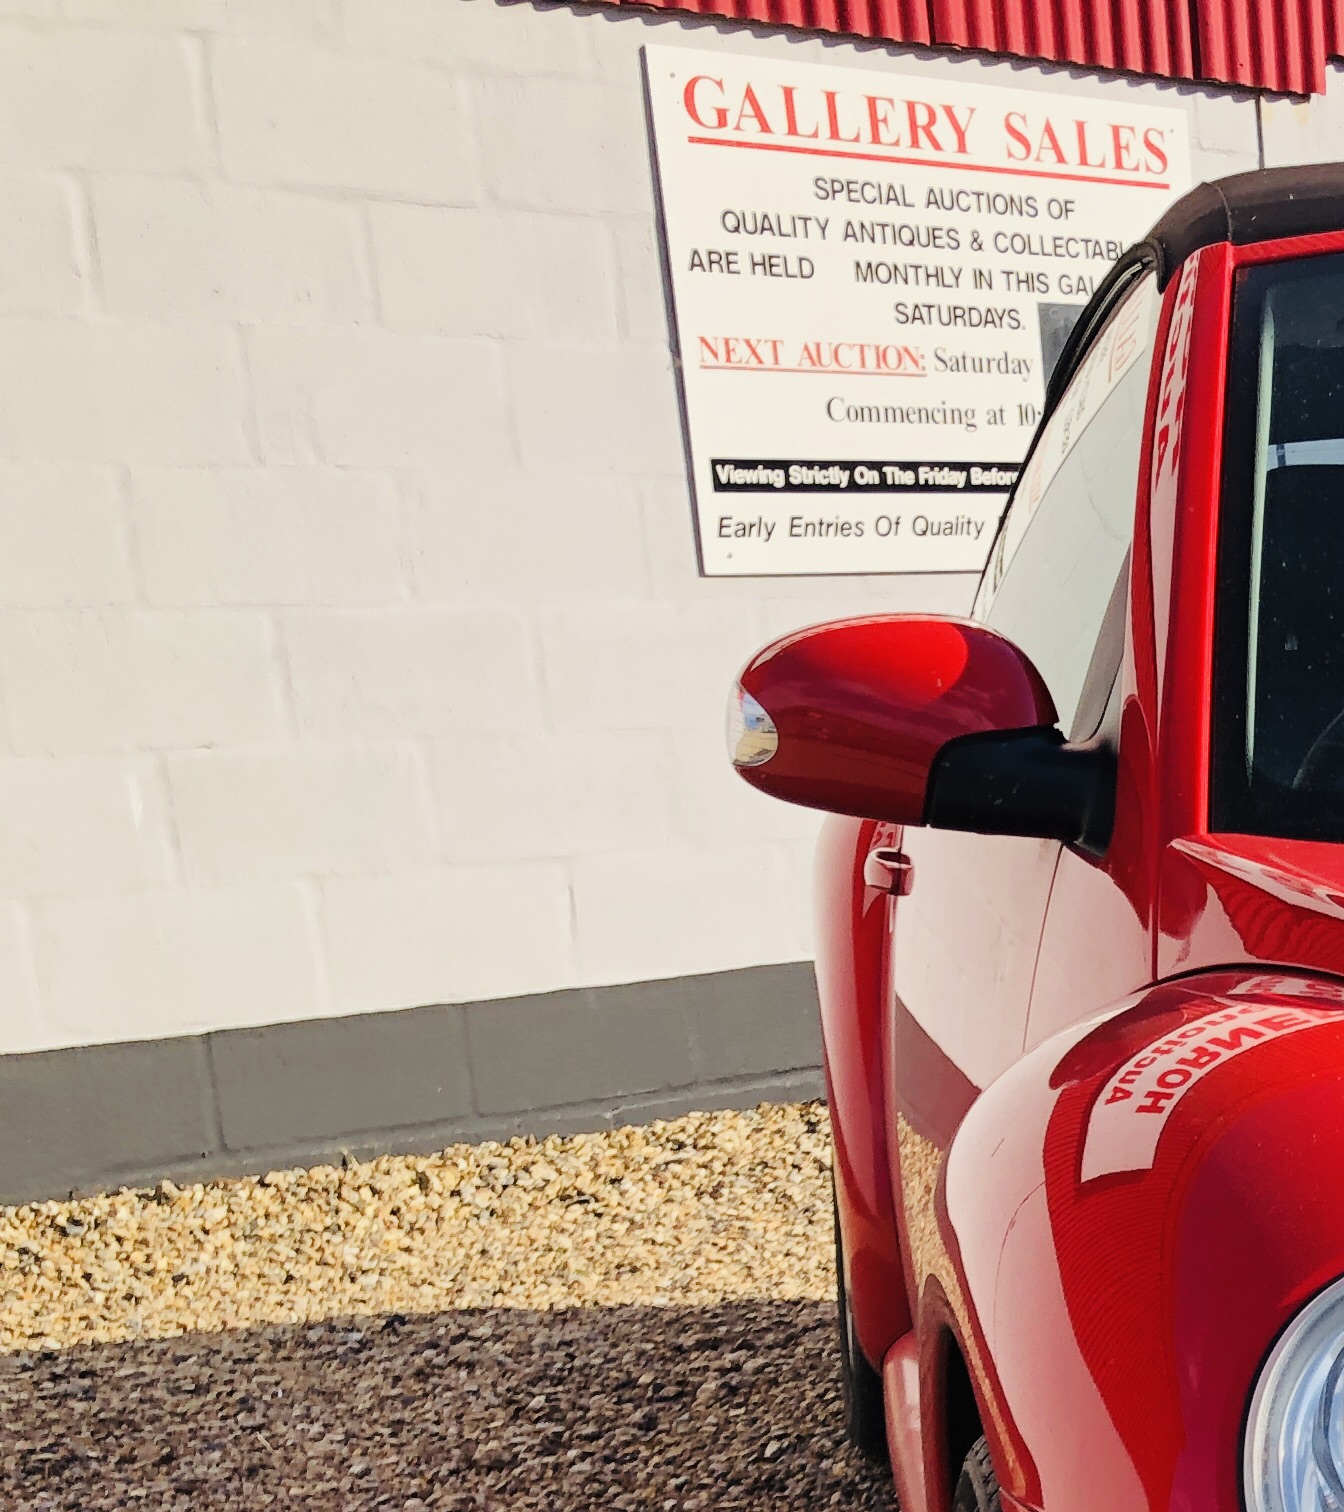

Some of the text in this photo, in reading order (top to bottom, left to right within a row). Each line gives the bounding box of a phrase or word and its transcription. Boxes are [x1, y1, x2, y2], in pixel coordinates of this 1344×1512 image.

[683, 75, 1169, 175] GALLERY SALES
[813, 176, 1076, 220] SPECIAL AUCTIONS OF
[721, 209, 830, 240] QUALITY
[842, 219, 961, 251] ANTIQUES
[970, 230, 984, 252] &
[688, 248, 741, 274] ARE
[749, 253, 815, 279] HELD
[854, 259, 963, 289] MONTHLY
[973, 268, 993, 290] IN
[1001, 270, 1050, 294] THIS
[894, 302, 1026, 331] SATURDAYS.
[698, 336, 1034, 382] NEXT AUCTION: Saturday
[826, 396, 978, 433] Commencing
[986, 403, 1006, 426] at
[715, 464, 786, 489] Viewing
[788, 464, 851, 489] Strictly
[853, 465, 881, 486] On
[882, 466, 916, 486] The
[918, 466, 968, 489] Friday
[718, 515, 777, 542] Early
[788, 515, 865, 538] Entries
[875, 514, 901, 538] Of
[912, 514, 985, 541] Quality
